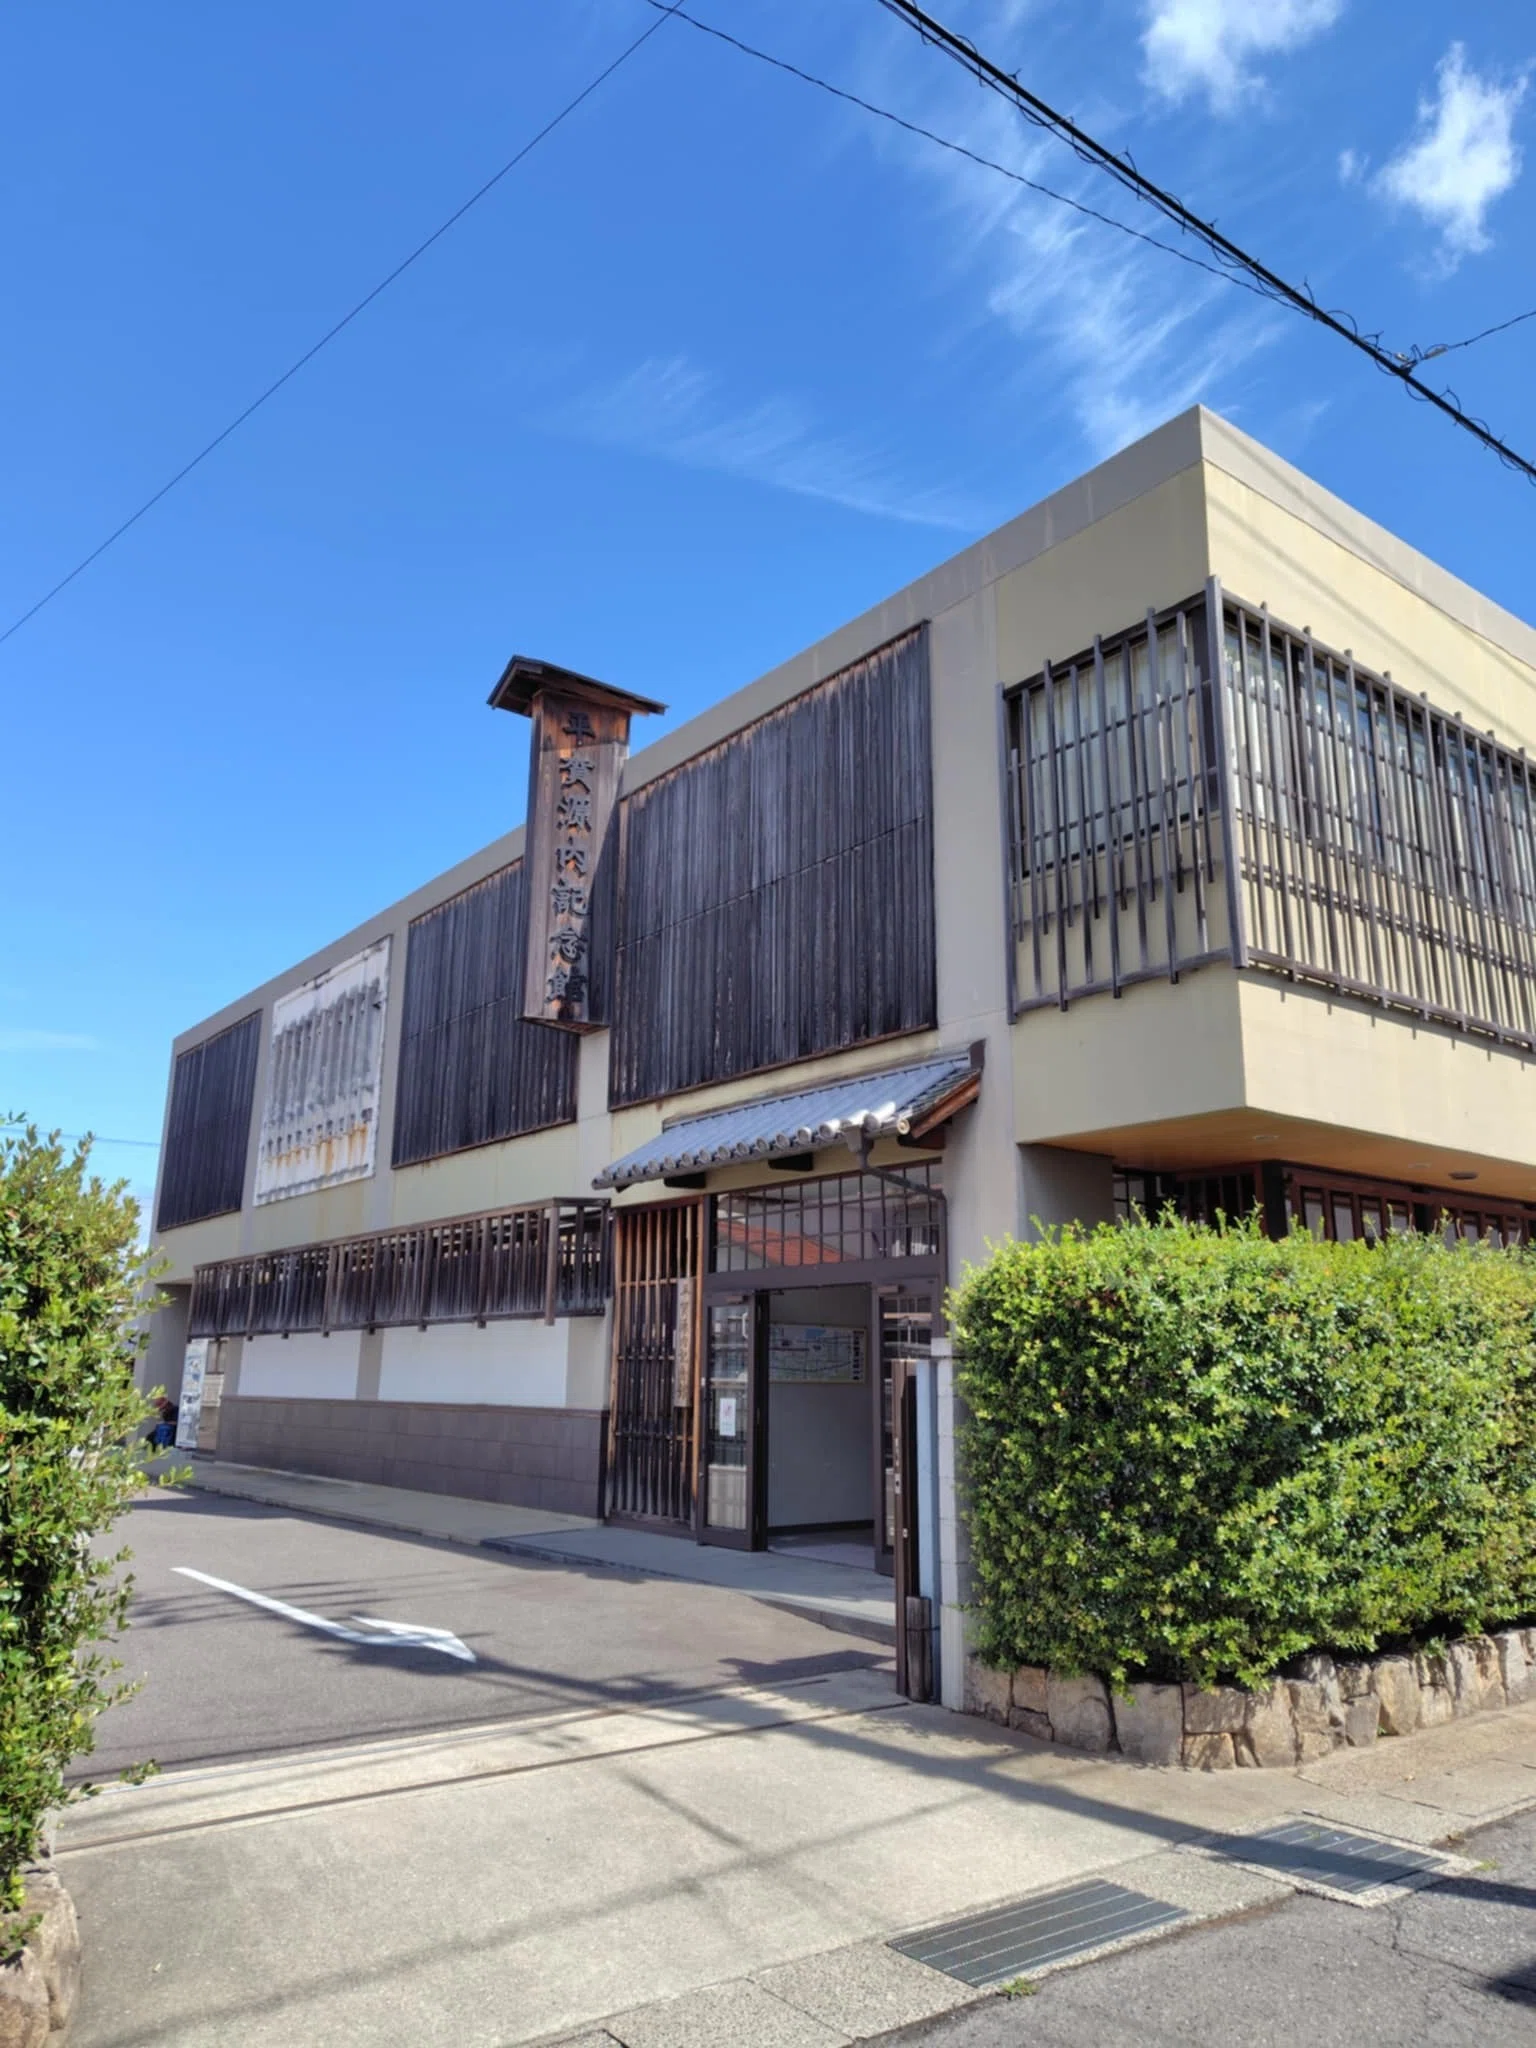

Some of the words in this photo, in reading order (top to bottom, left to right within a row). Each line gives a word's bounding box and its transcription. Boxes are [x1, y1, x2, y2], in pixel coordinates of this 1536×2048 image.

[548, 713, 595, 1001] 平賀源内記念館
